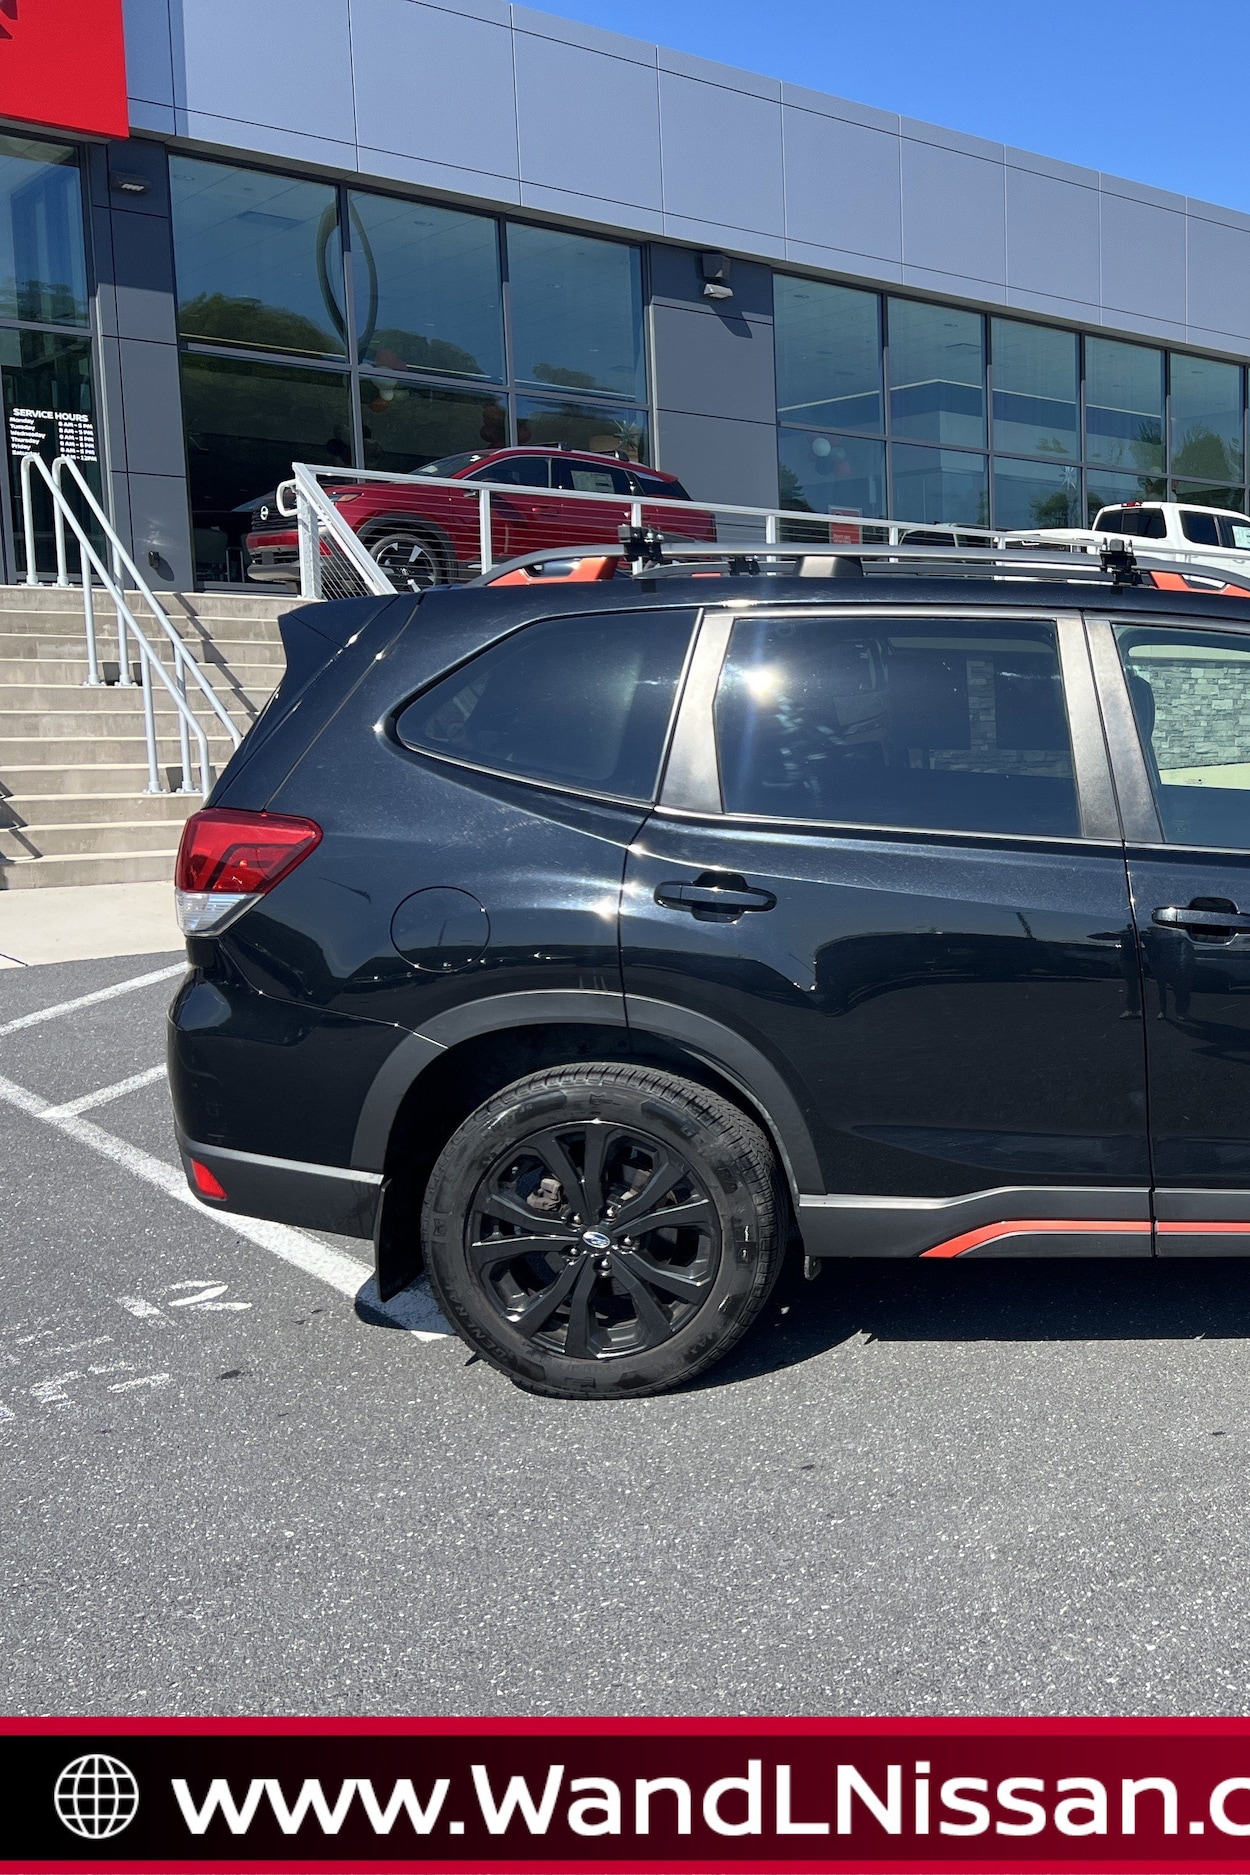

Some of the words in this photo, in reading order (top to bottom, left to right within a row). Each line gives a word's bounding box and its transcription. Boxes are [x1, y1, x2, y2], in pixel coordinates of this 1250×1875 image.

[13, 408, 54, 419] SERVICE
[55, 412, 89, 422] HOURS
[9, 417, 34, 425] Monday
[10, 430, 46, 439] Wednesday
[11, 436, 40, 445] Thursday
[11, 443, 31, 451] Friday
